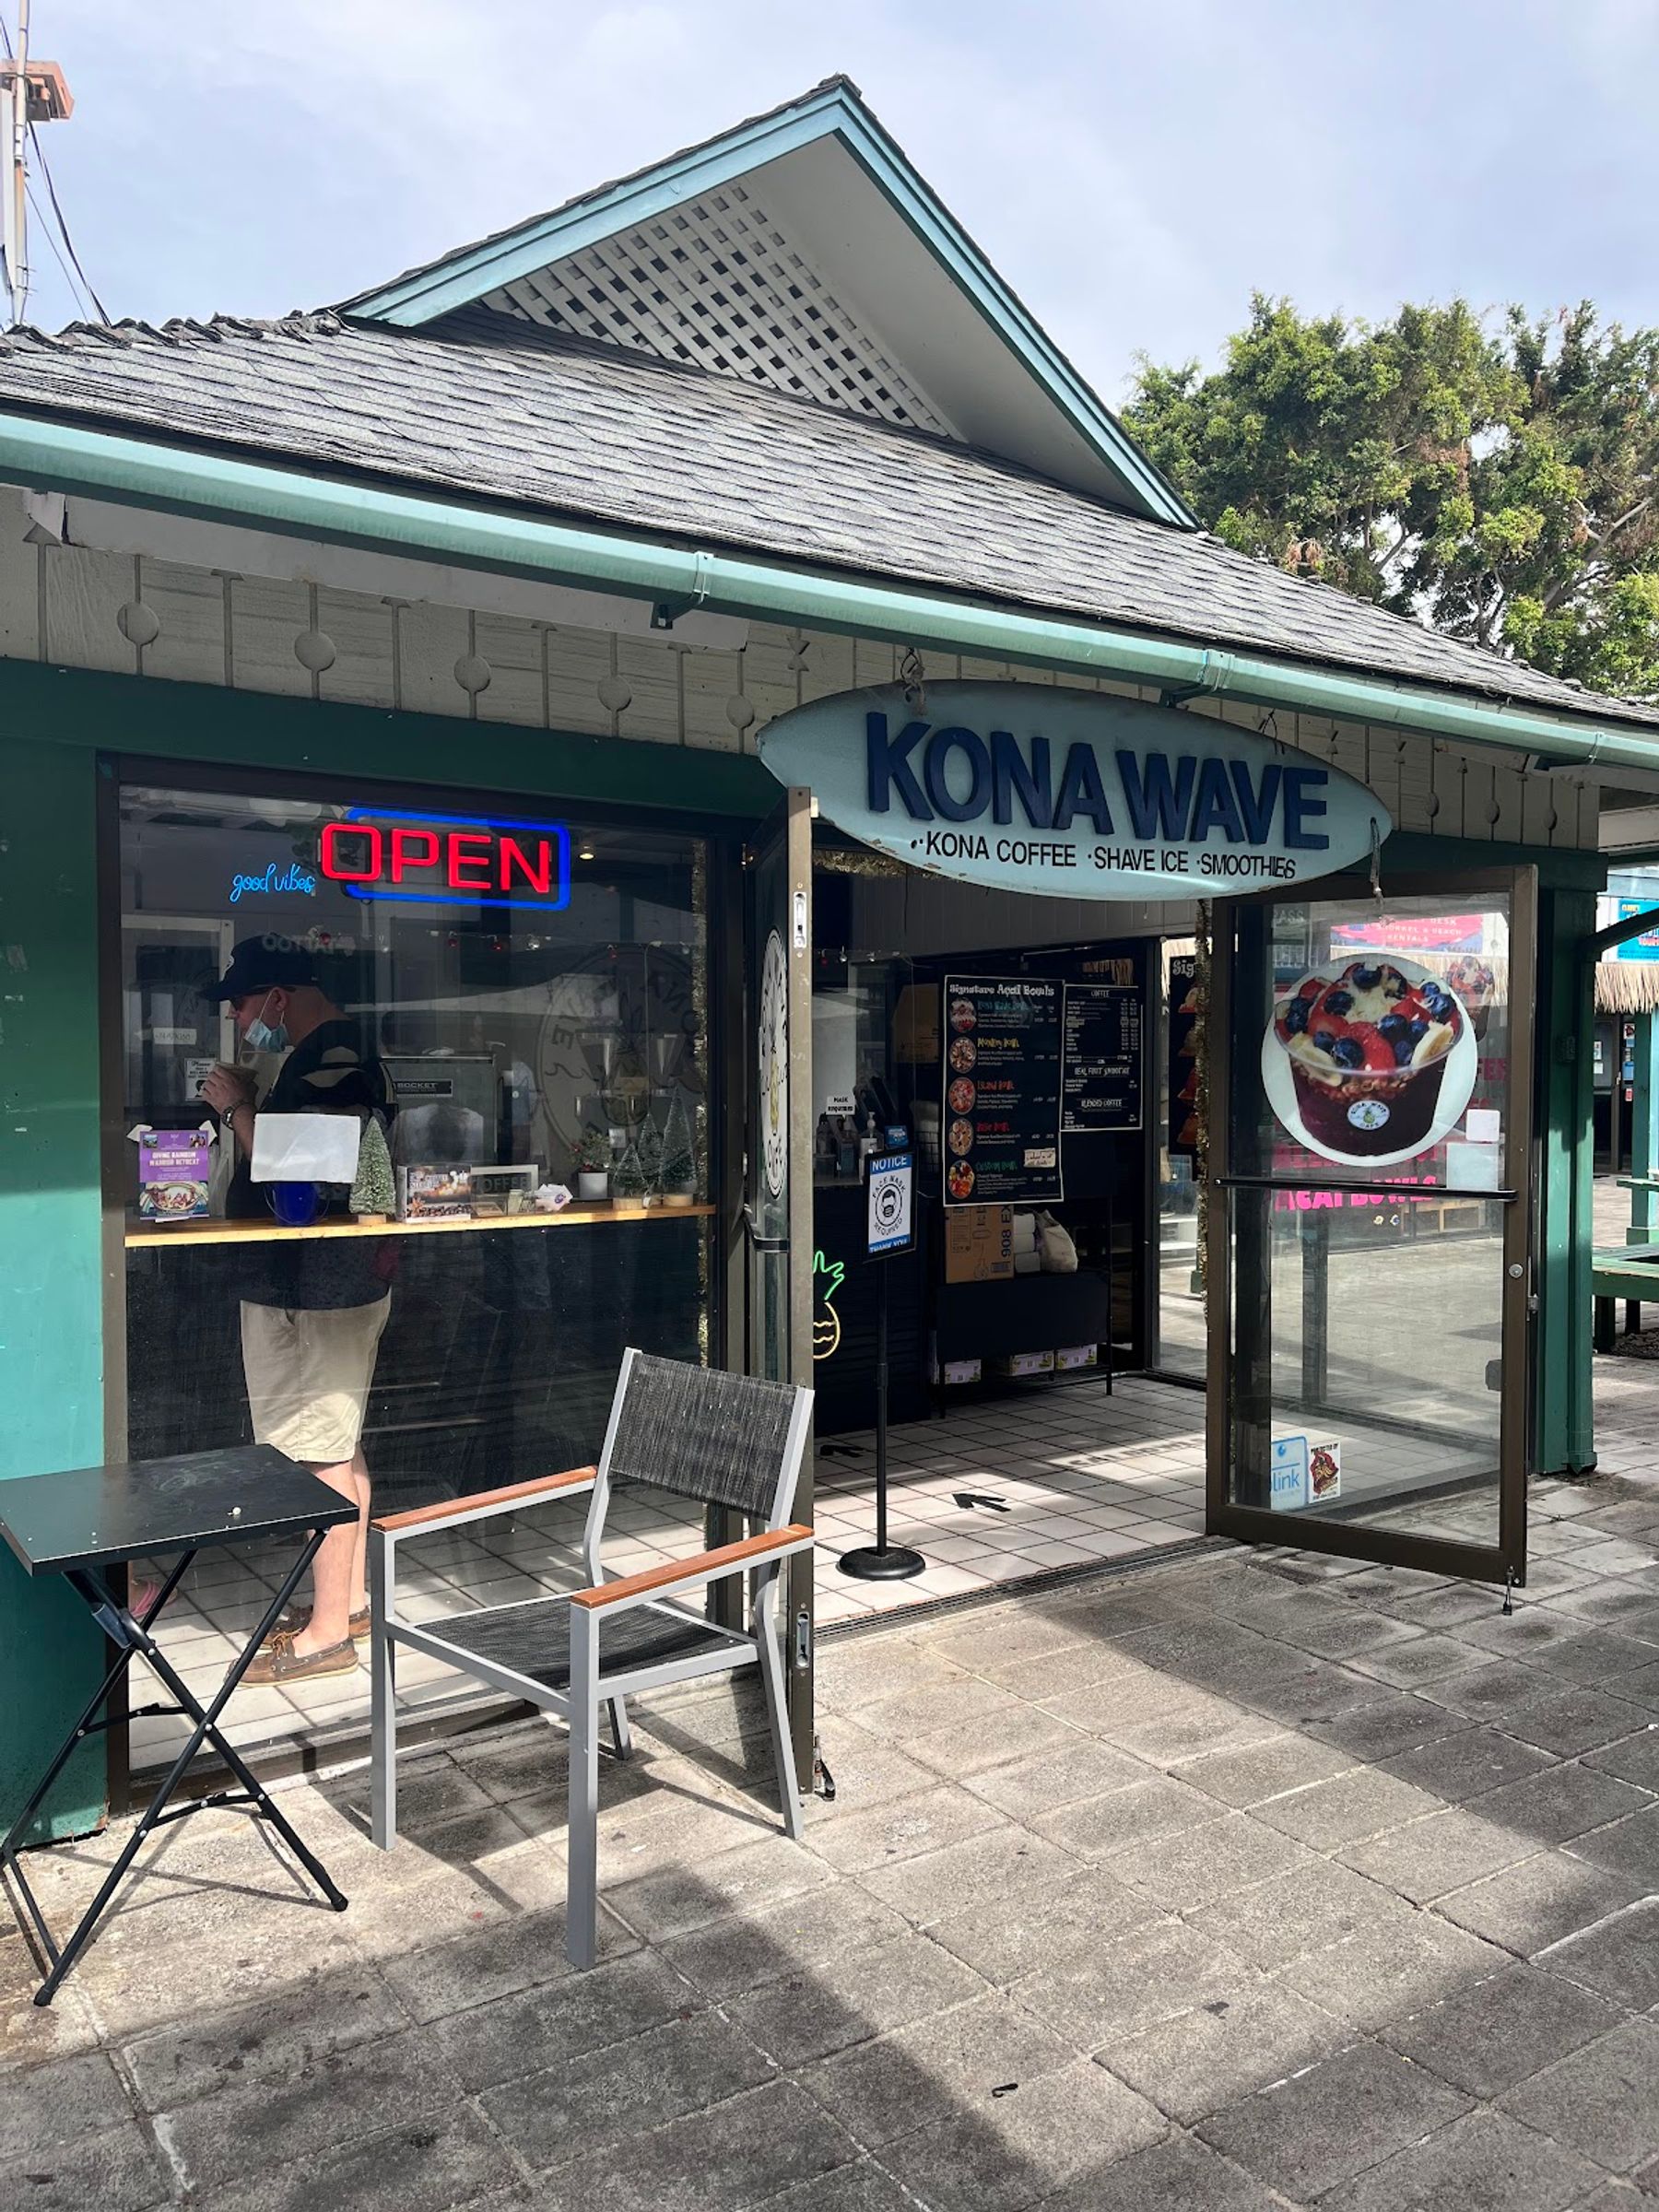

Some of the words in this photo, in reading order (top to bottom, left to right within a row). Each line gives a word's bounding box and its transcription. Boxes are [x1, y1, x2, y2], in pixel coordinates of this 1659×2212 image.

[866, 712, 1114, 835] KONA
[1115, 749, 1330, 851] WAVE
[323, 823, 550, 894] OPEN
[996, 840, 1077, 866] COFFEE
[1161, 850, 1189, 873] ICE
[229, 863, 270, 902] good
[274, 863, 315, 895] vibes
[872, 1155, 908, 1172] NOTICE
[1273, 1468, 1300, 1491] link
